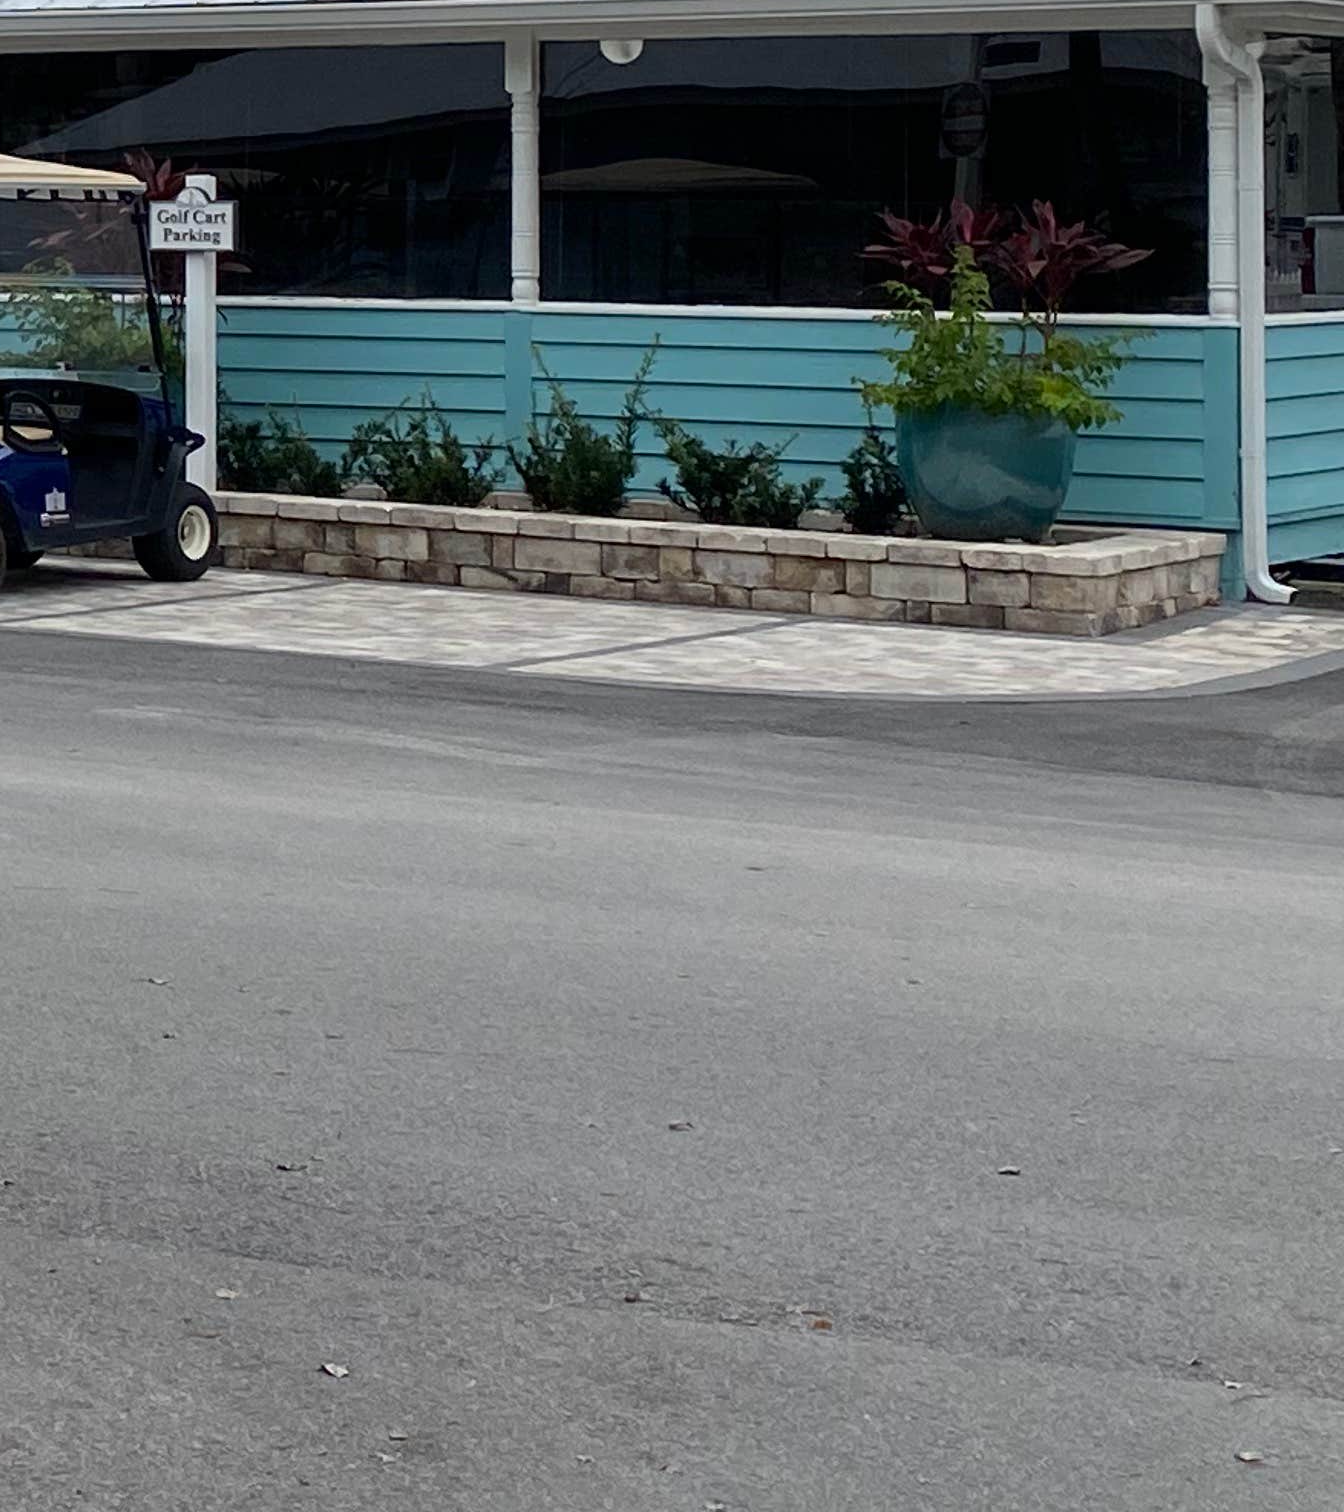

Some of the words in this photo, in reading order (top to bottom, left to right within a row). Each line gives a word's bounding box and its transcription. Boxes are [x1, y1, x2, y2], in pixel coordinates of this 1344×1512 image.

[157, 209, 190, 224] Golf
[193, 209, 226, 224] Cart
[163, 228, 221, 245] Parking
